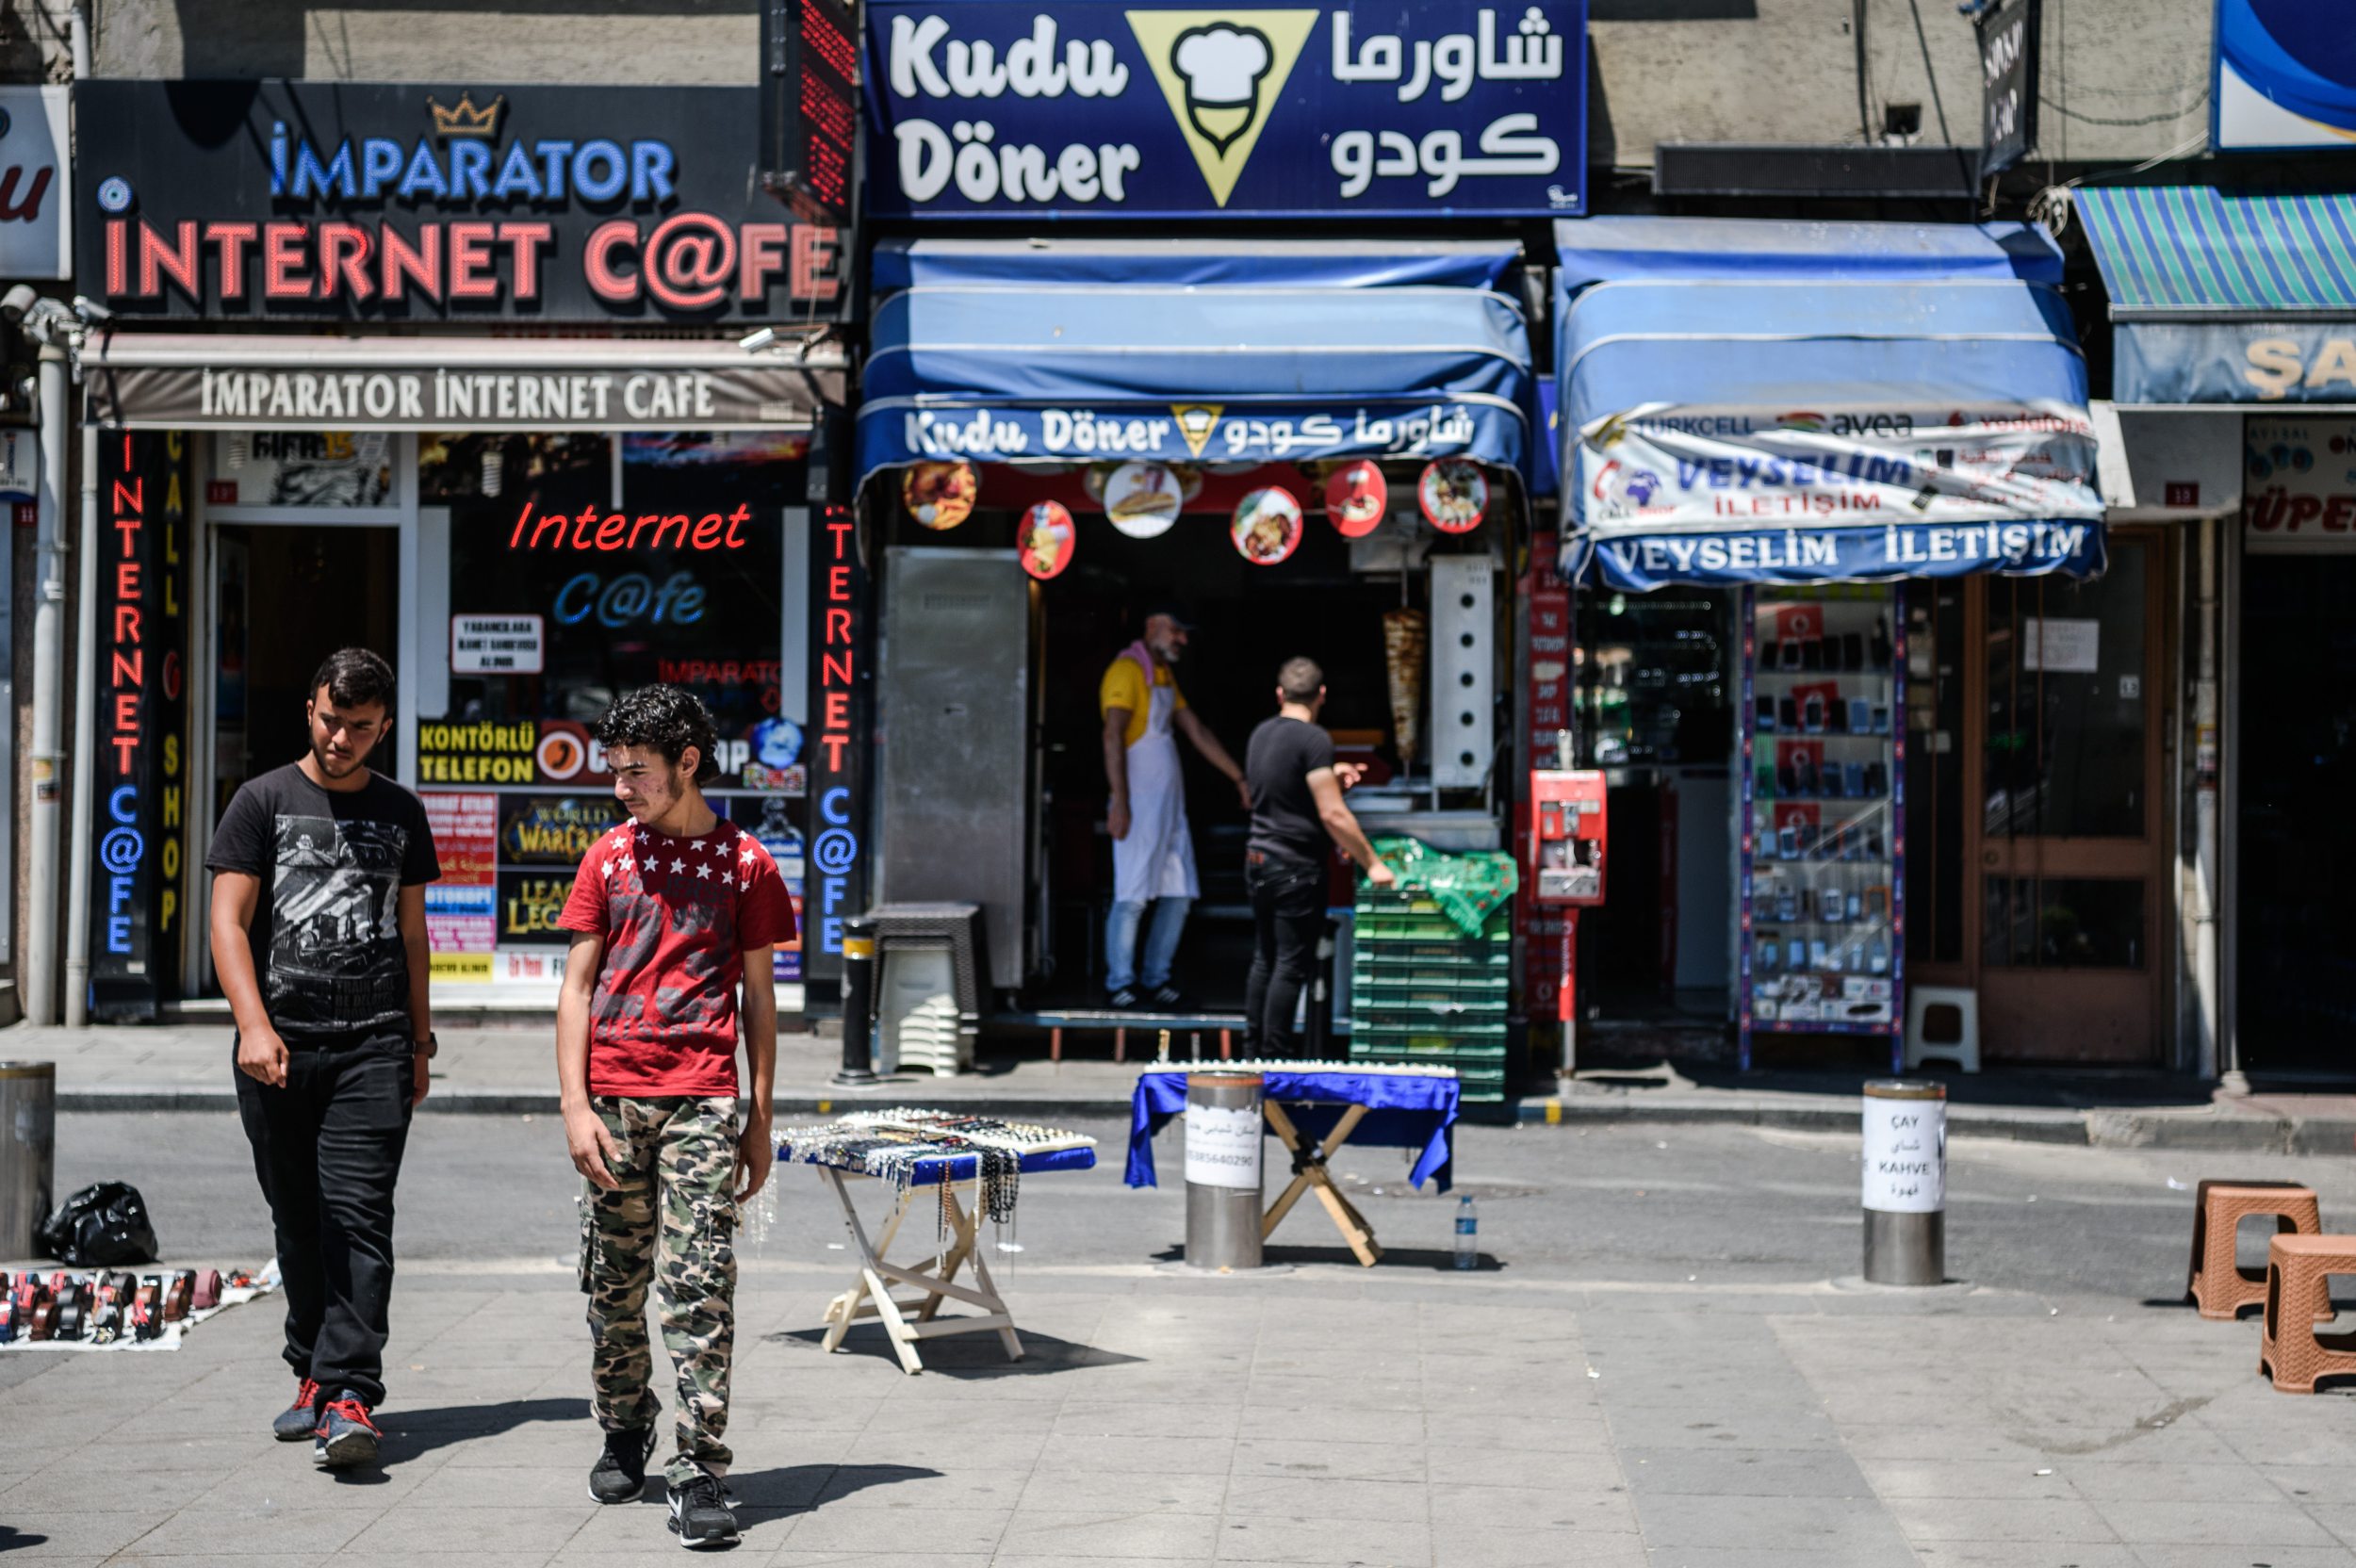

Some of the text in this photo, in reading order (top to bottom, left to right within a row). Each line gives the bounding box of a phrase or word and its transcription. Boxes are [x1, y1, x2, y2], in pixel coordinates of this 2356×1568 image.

[890, 14, 1129, 98] Kudu
[1332, 7, 1562, 103] شاورما
[893, 119, 1140, 203] Döner
[1331, 112, 1561, 198] كودو
[584, 213, 842, 311] C@FE
[201, 367, 423, 416] İMPARATOR
[624, 376, 715, 417] CAFE
[905, 408, 1170, 454] Kudu Döner
[1225, 405, 1475, 454] شاورما كودو
[1831, 412, 1914, 437] avea
[1980, 410, 2089, 434] vodafone
[2246, 486, 2356, 532] ÜPE
[554, 570, 705, 629] C@fe
[419, 720, 534, 752] KONTÖRLÜ
[419, 756, 534, 782] TELEFON
[161, 732, 181, 933] SHOP
[99, 783, 144, 954] C@FE
[1878, 1160, 1931, 1176] KAHVE
